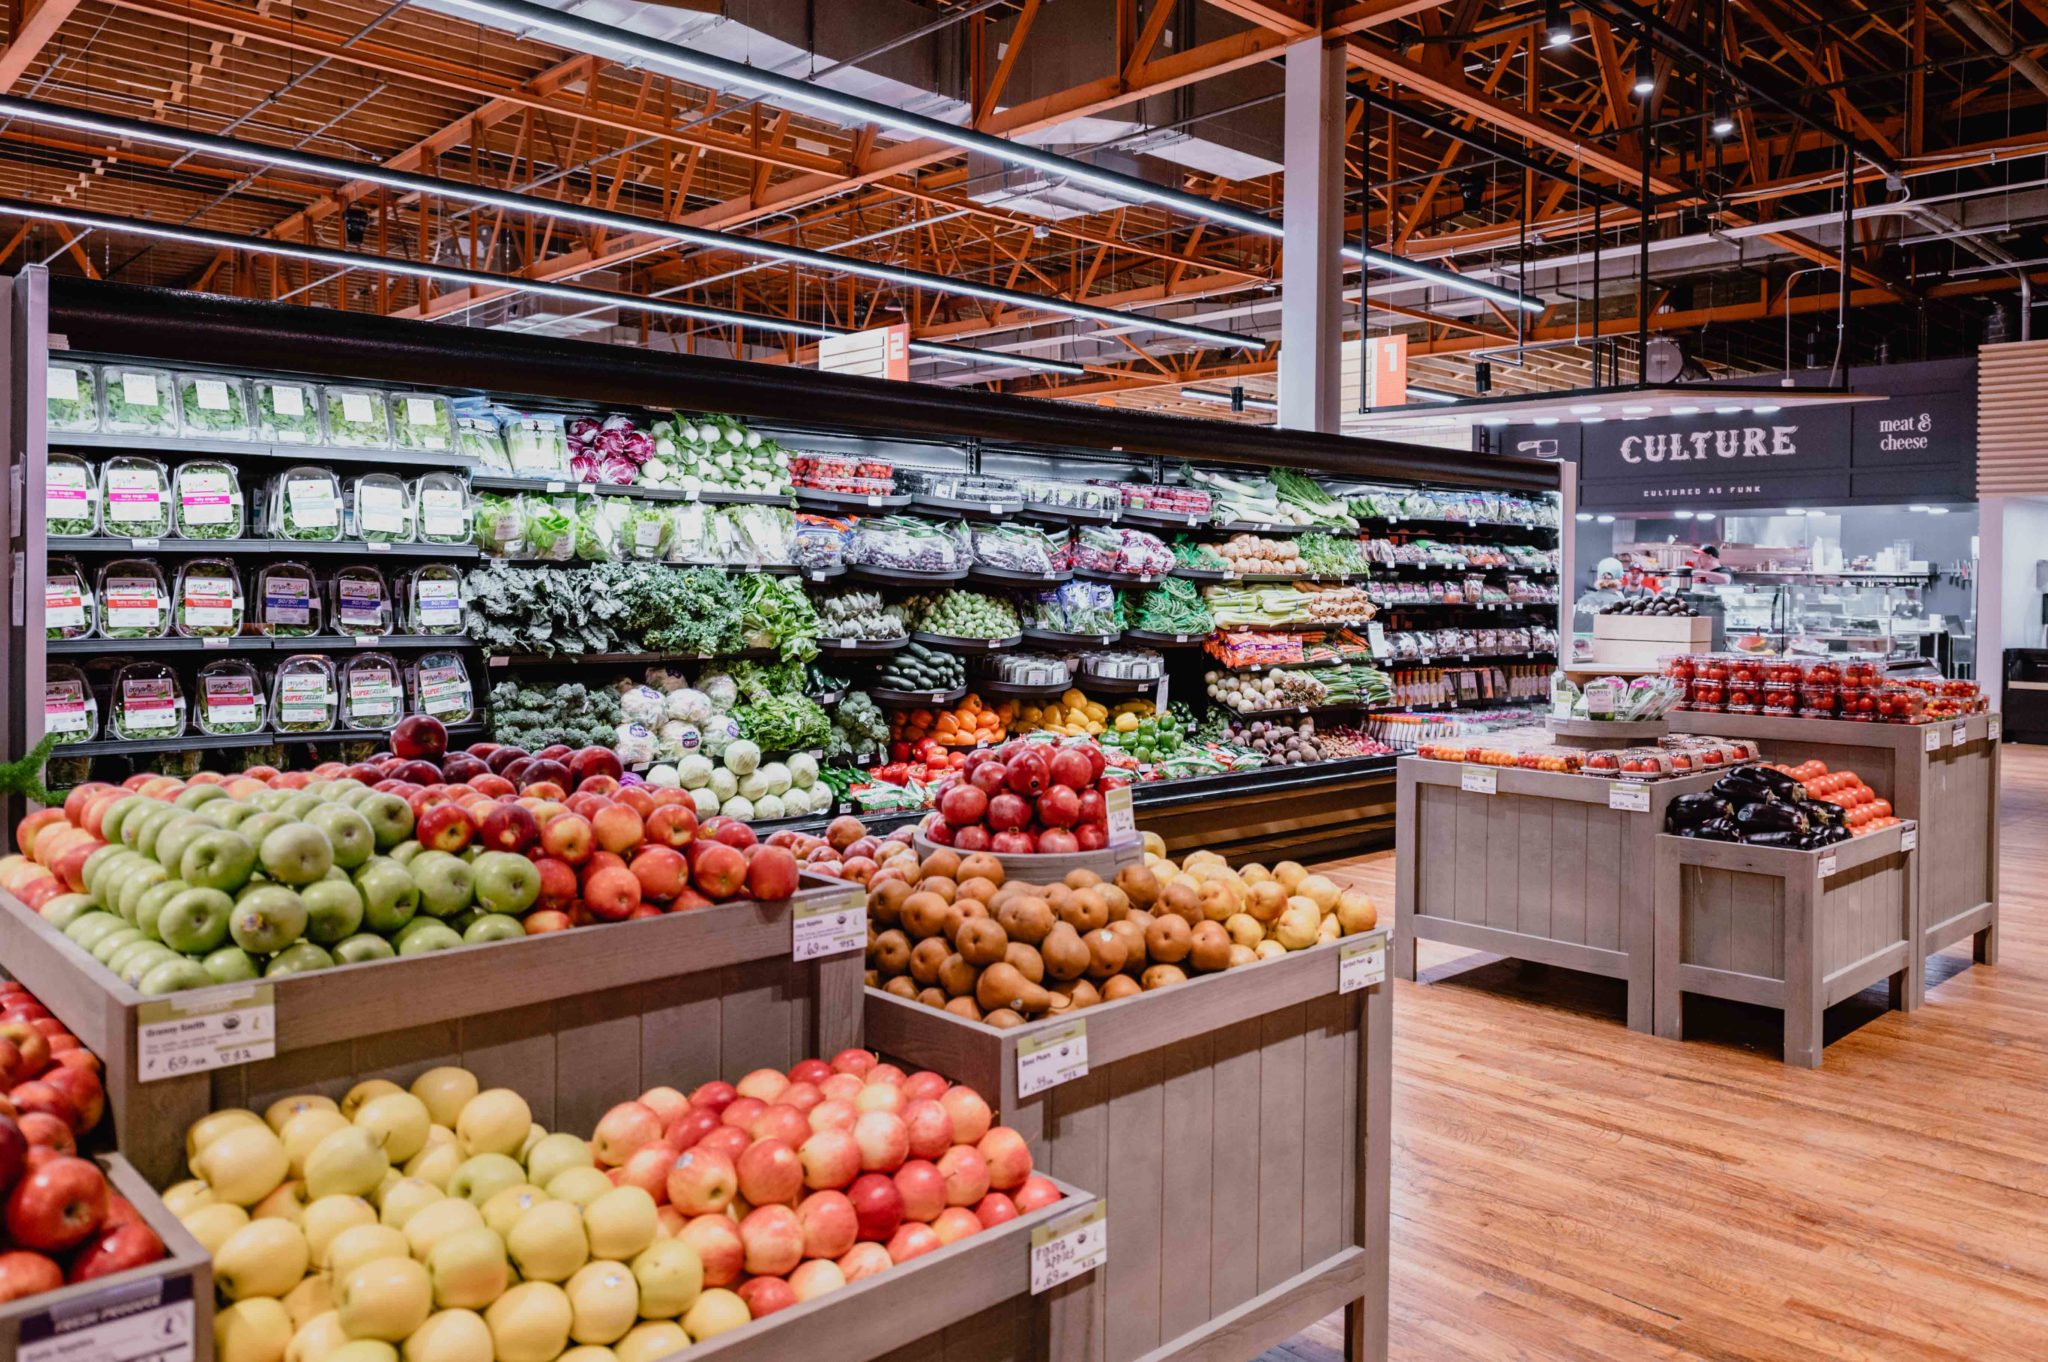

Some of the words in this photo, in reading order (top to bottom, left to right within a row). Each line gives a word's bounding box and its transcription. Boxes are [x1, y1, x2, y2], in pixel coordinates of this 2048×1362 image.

[890, 331, 904, 361] 2
[1384, 343, 1398, 372] 1
[1880, 417, 1914, 432] meat
[1918, 413, 1932, 432] &
[1620, 425, 1799, 464] CULTURE
[1880, 434, 1928, 451] cheese
[1643, 487, 1700, 497] CULTURED
[1729, 485, 1761, 494] FUNK
